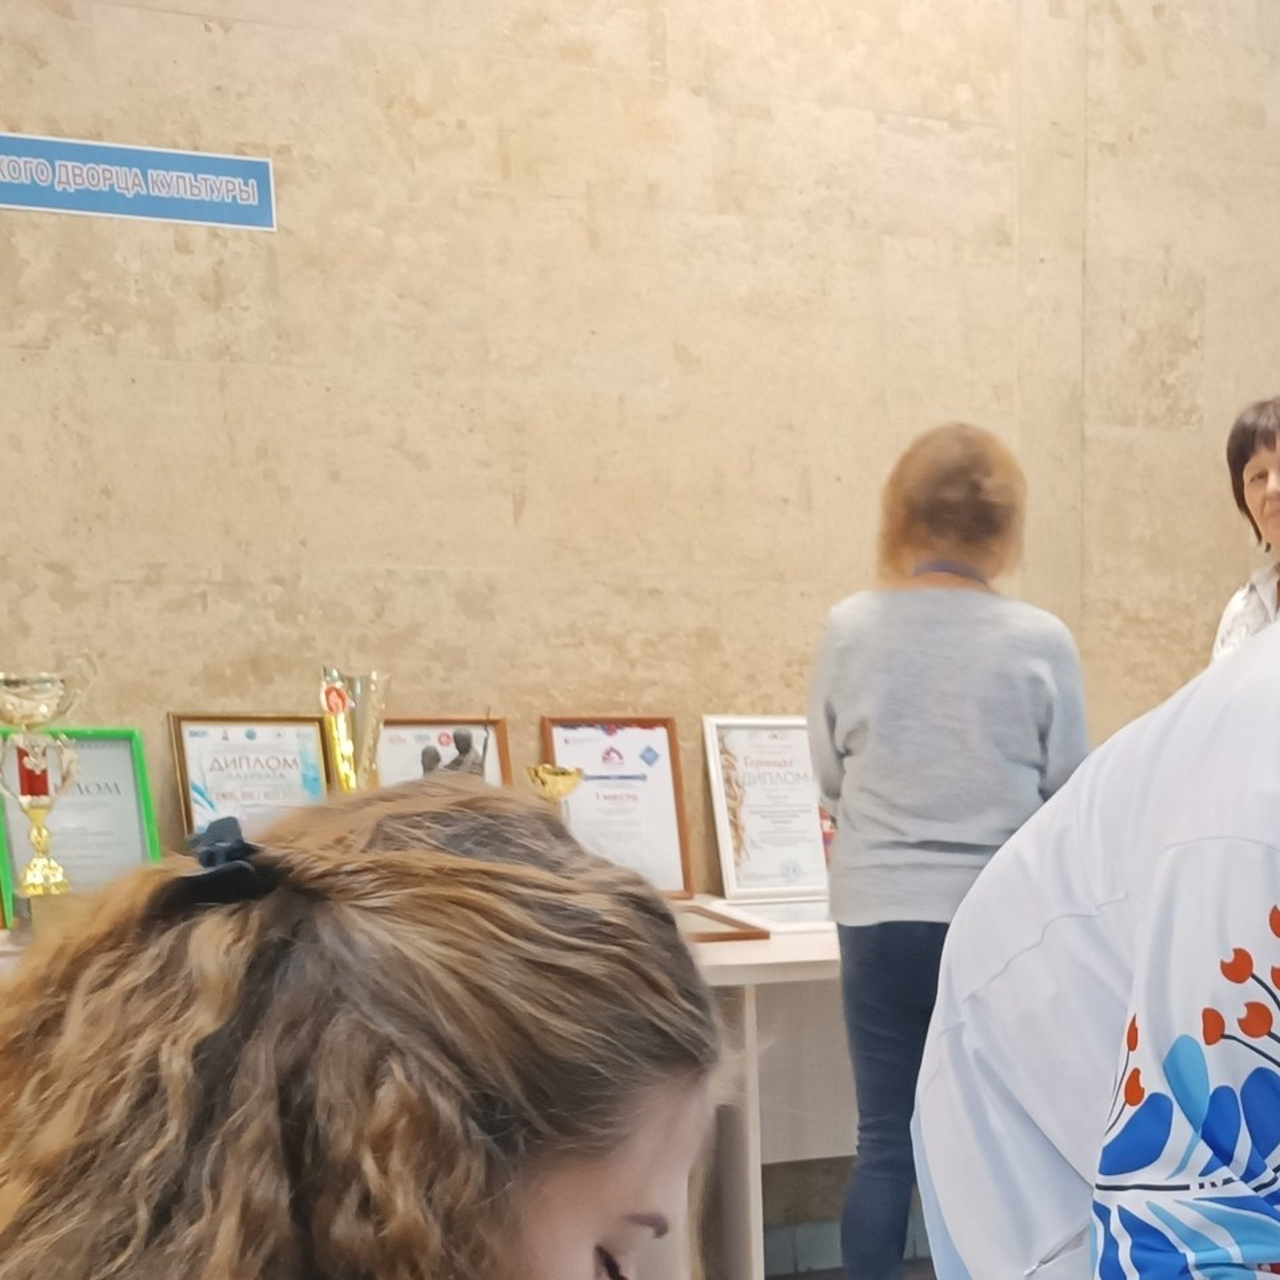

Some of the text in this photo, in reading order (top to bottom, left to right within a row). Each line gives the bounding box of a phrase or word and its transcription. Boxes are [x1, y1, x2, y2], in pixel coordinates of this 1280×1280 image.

[55, 161, 145, 197] ДВОРЦА
[148, 170, 258, 205] КУЛЬТУРЫ
[209, 755, 299, 772] ДИПЛОМ
